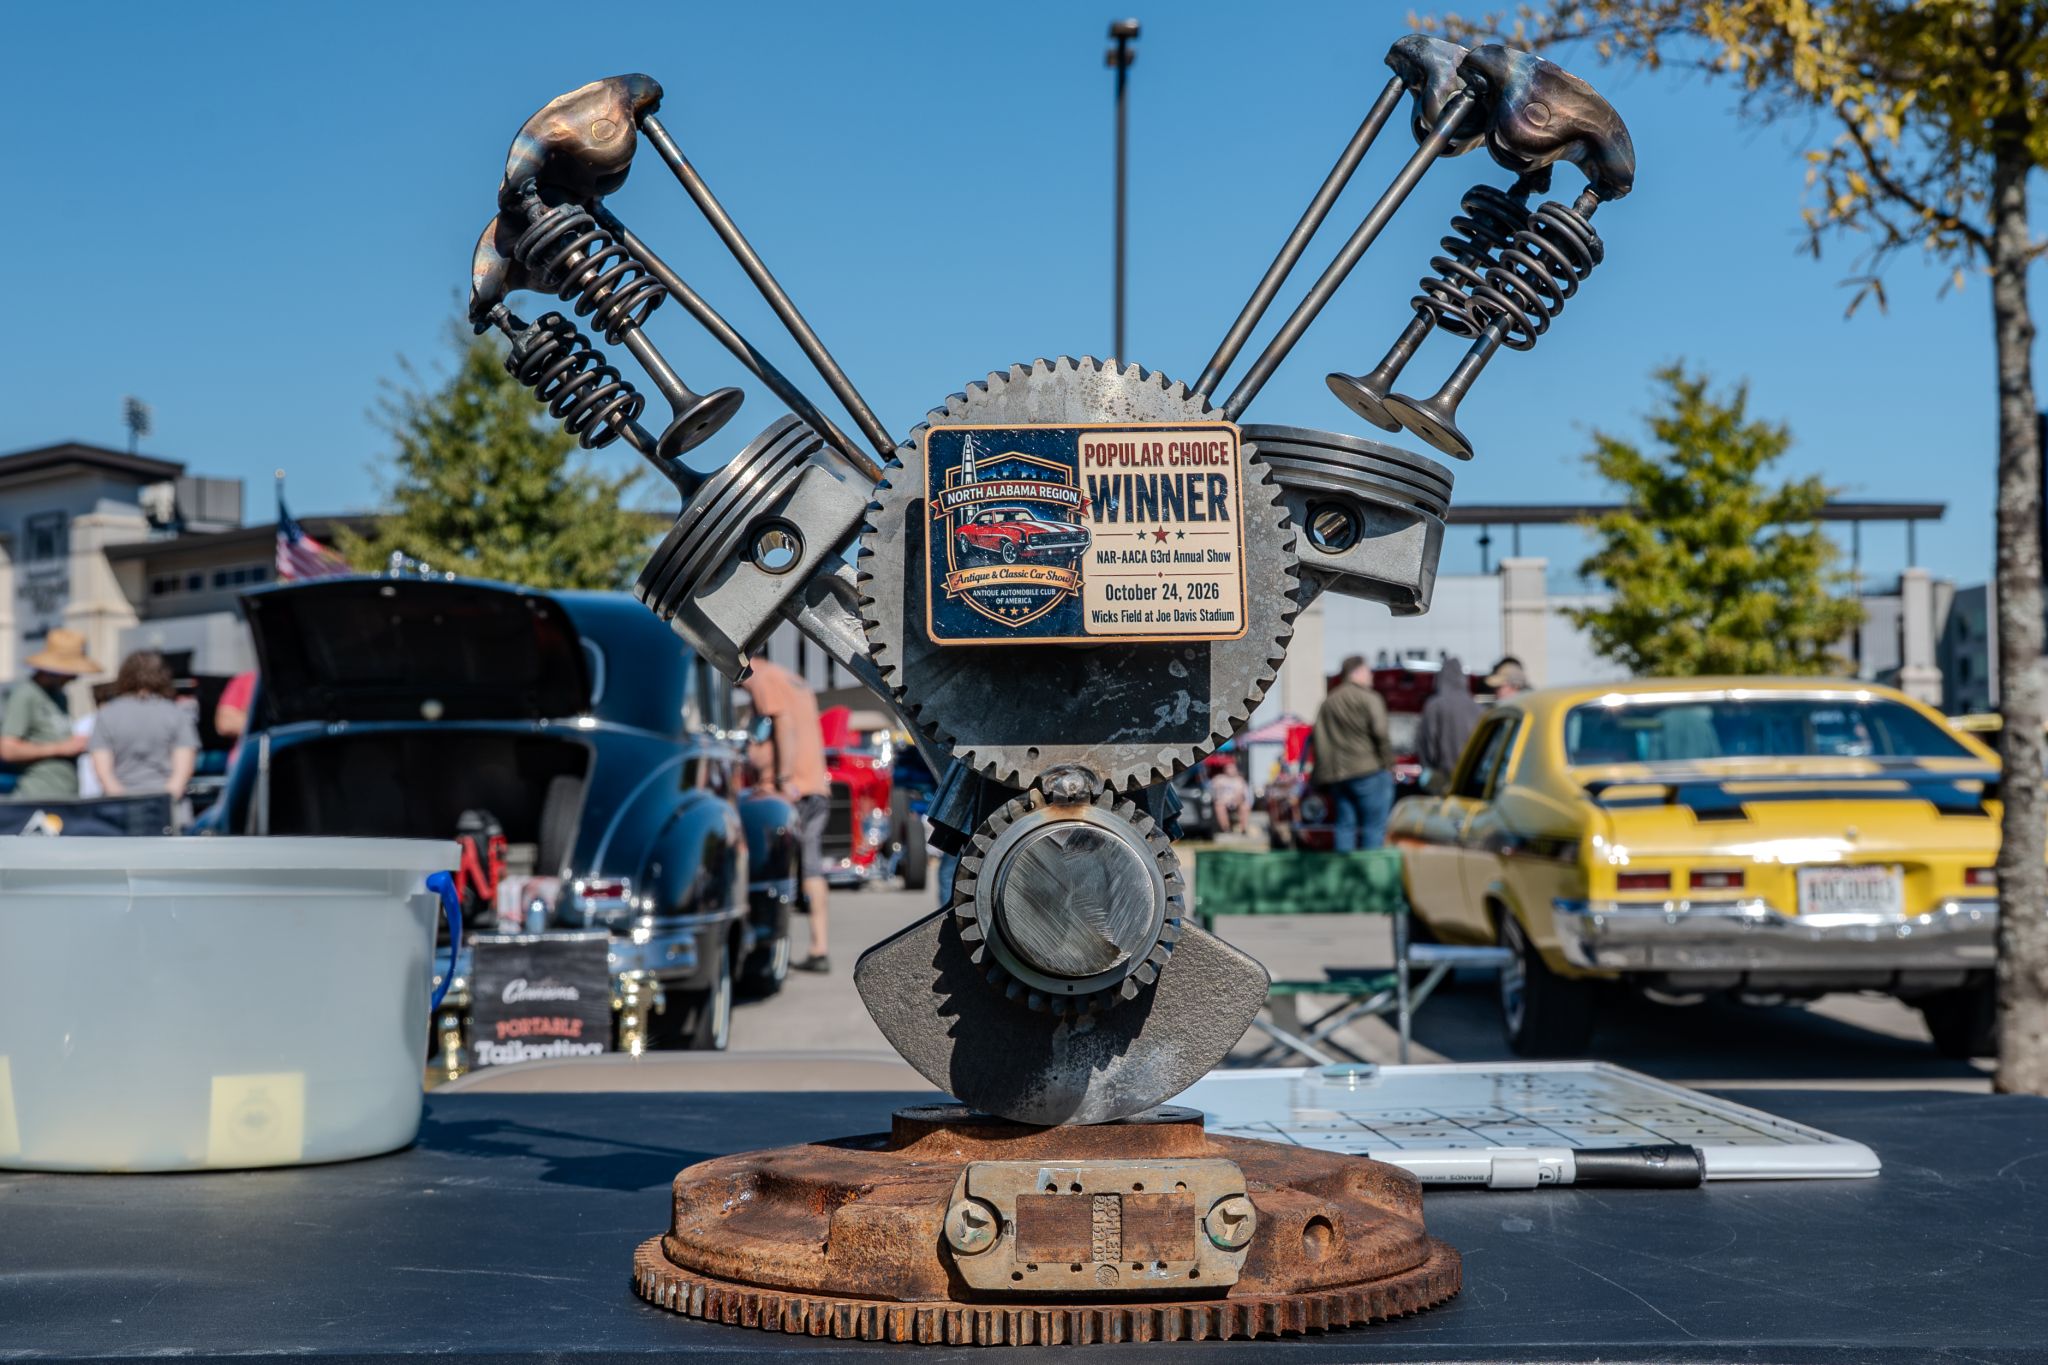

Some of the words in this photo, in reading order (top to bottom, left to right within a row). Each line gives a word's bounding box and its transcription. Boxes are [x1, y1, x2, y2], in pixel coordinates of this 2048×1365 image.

[1084, 443, 1164, 467] POPULAR
[1168, 441, 1230, 466] CHOICE
[947, 487, 984, 505] NORTH
[986, 485, 1037, 498] ALABAMA
[1039, 488, 1078, 504] REGION
[1086, 473, 1231, 523] WINNER
[1096, 551, 1148, 564] NAR-AACA
[1150, 550, 1171, 563] 63rd
[1173, 550, 1204, 563] Annual
[1207, 549, 1231, 562] Show
[954, 572, 990, 585] Antique
[991, 571, 998, 579] &
[999, 568, 1029, 579] Classic
[1029, 569, 1045, 579] Car
[1045, 570, 1073, 583] Show
[972, 589, 999, 597] ANTIQUE
[1000, 588, 1039, 596] AUTOMOBILE
[1040, 588, 1056, 596] CLUB
[1004, 597, 1032, 605] AMERICA
[1105, 584, 1157, 601] October
[1162, 583, 1182, 603] 24,
[1187, 583, 1220, 600] 2026
[1091, 610, 1119, 623] Wicks
[1121, 610, 1142, 623] Field
[1144, 611, 1154, 622] at
[1156, 610, 1171, 622] Joe
[1173, 609, 1197, 622] Davis
[1200, 608, 1235, 621] Stadium
[1105, 1195, 1121, 1260] KOHLER
